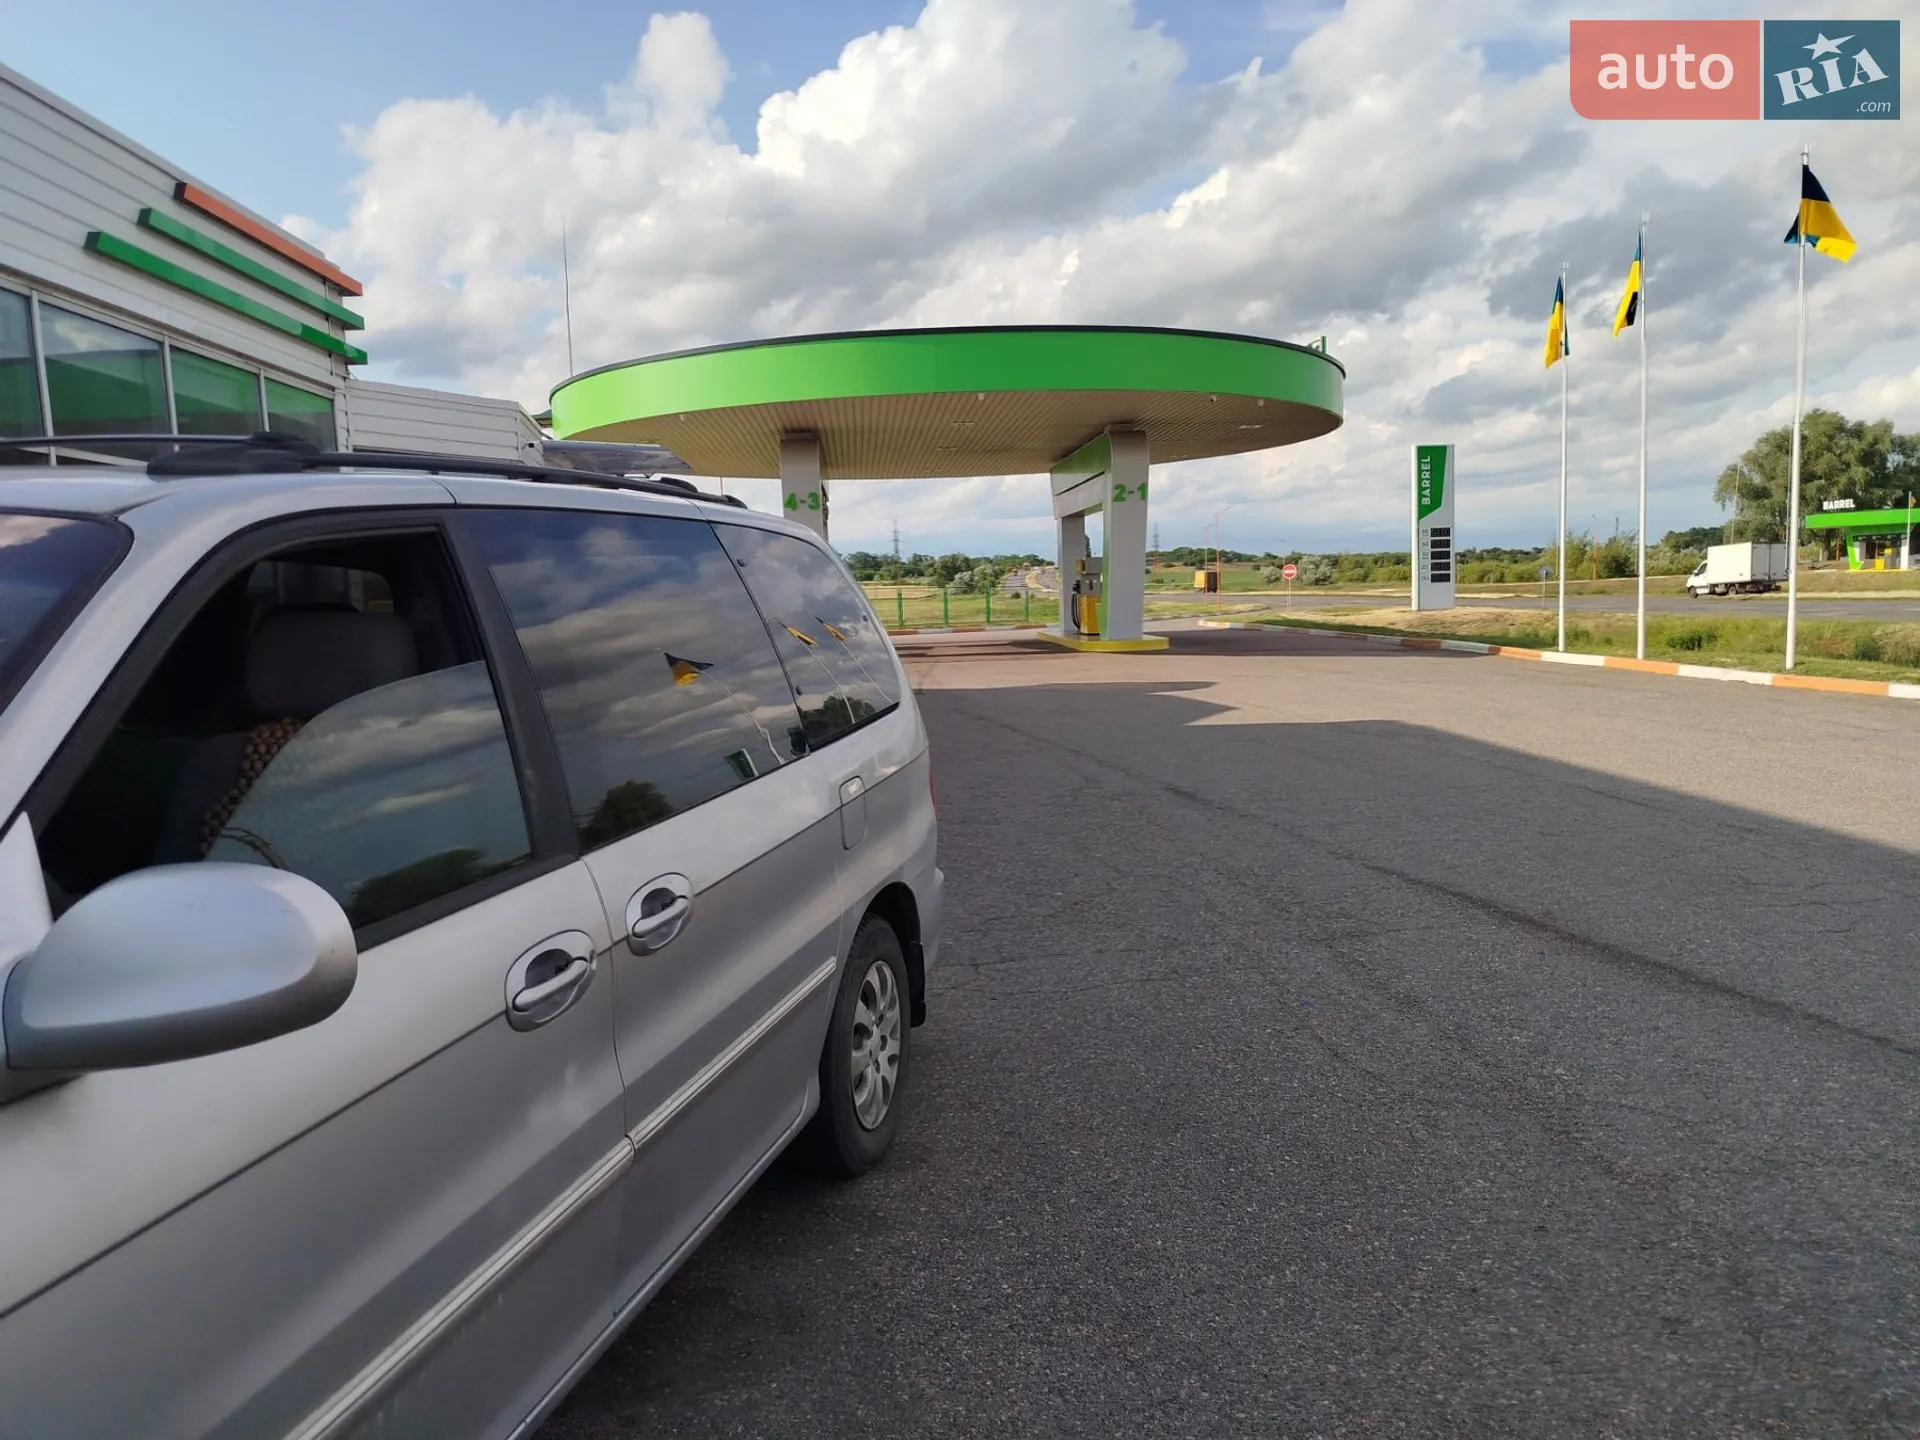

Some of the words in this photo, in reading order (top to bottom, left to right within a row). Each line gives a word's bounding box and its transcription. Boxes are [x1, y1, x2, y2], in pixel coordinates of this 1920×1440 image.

[1421, 455, 1431, 505] BARREL
[784, 492, 820, 511] 4-3
[1112, 483, 1147, 502] 2-1
[1822, 499, 1855, 510] BARREL
